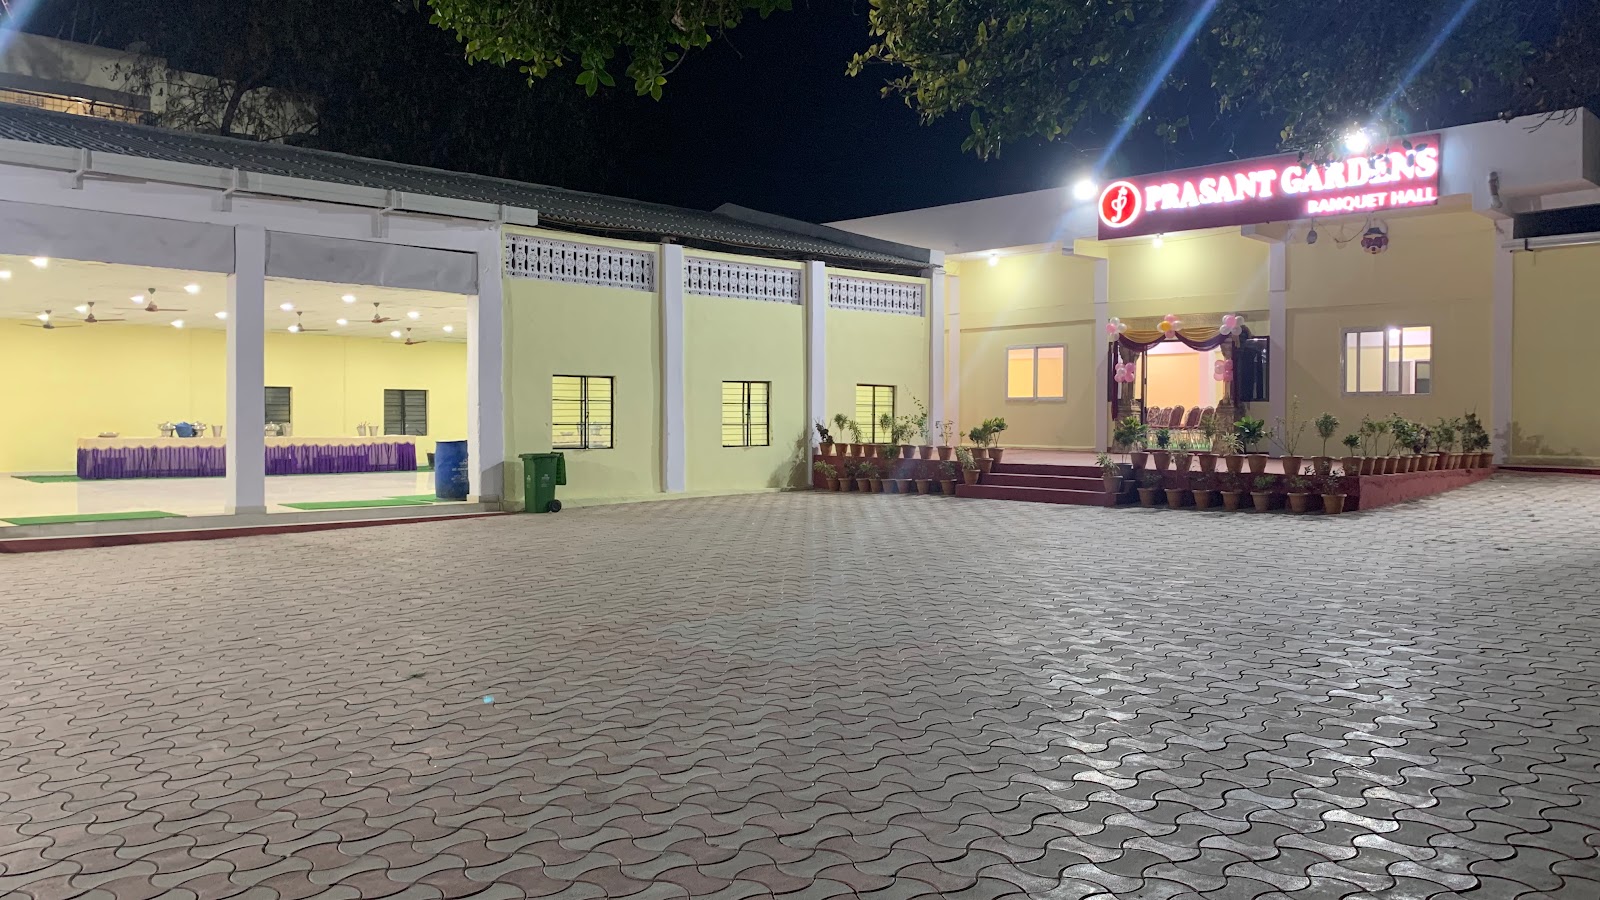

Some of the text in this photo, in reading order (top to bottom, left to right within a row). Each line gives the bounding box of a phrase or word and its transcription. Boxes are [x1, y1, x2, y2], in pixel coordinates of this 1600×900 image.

[1145, 169, 1277, 211] PRASANT
[1307, 187, 1438, 213] BANQUET HALL
